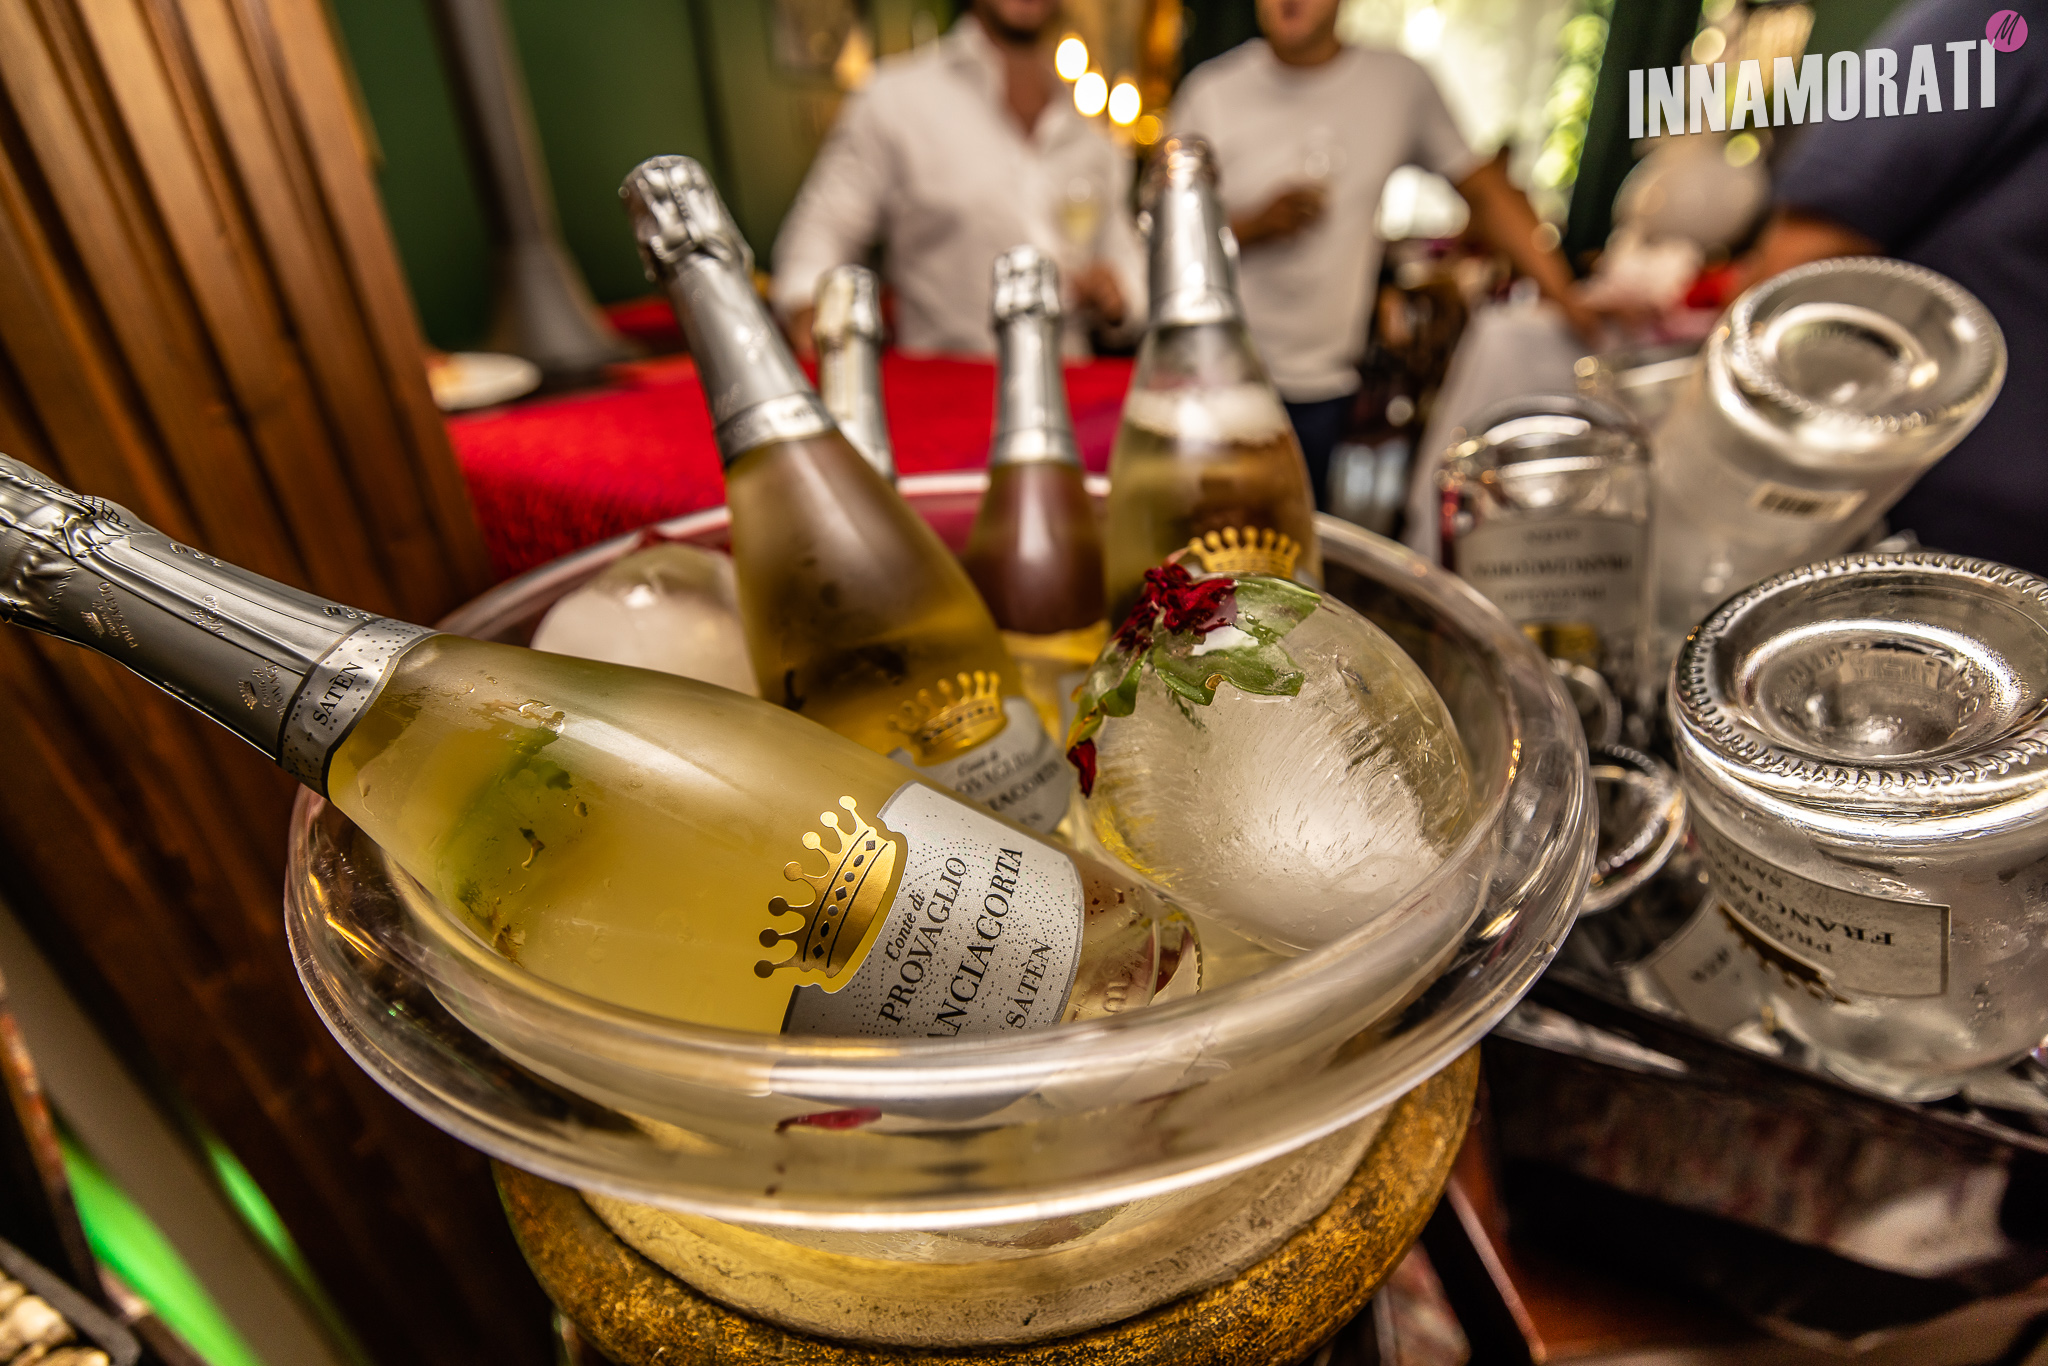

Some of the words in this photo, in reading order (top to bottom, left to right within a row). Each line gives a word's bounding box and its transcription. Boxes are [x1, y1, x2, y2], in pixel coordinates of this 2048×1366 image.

[98, 582, 138, 648] PROVAGLIO
[312, 661, 364, 726] SATÈN
[908, 889, 926, 912] di
[878, 857, 967, 1026] PROVAGLIO
[1005, 938, 1053, 1030] SATÈN
